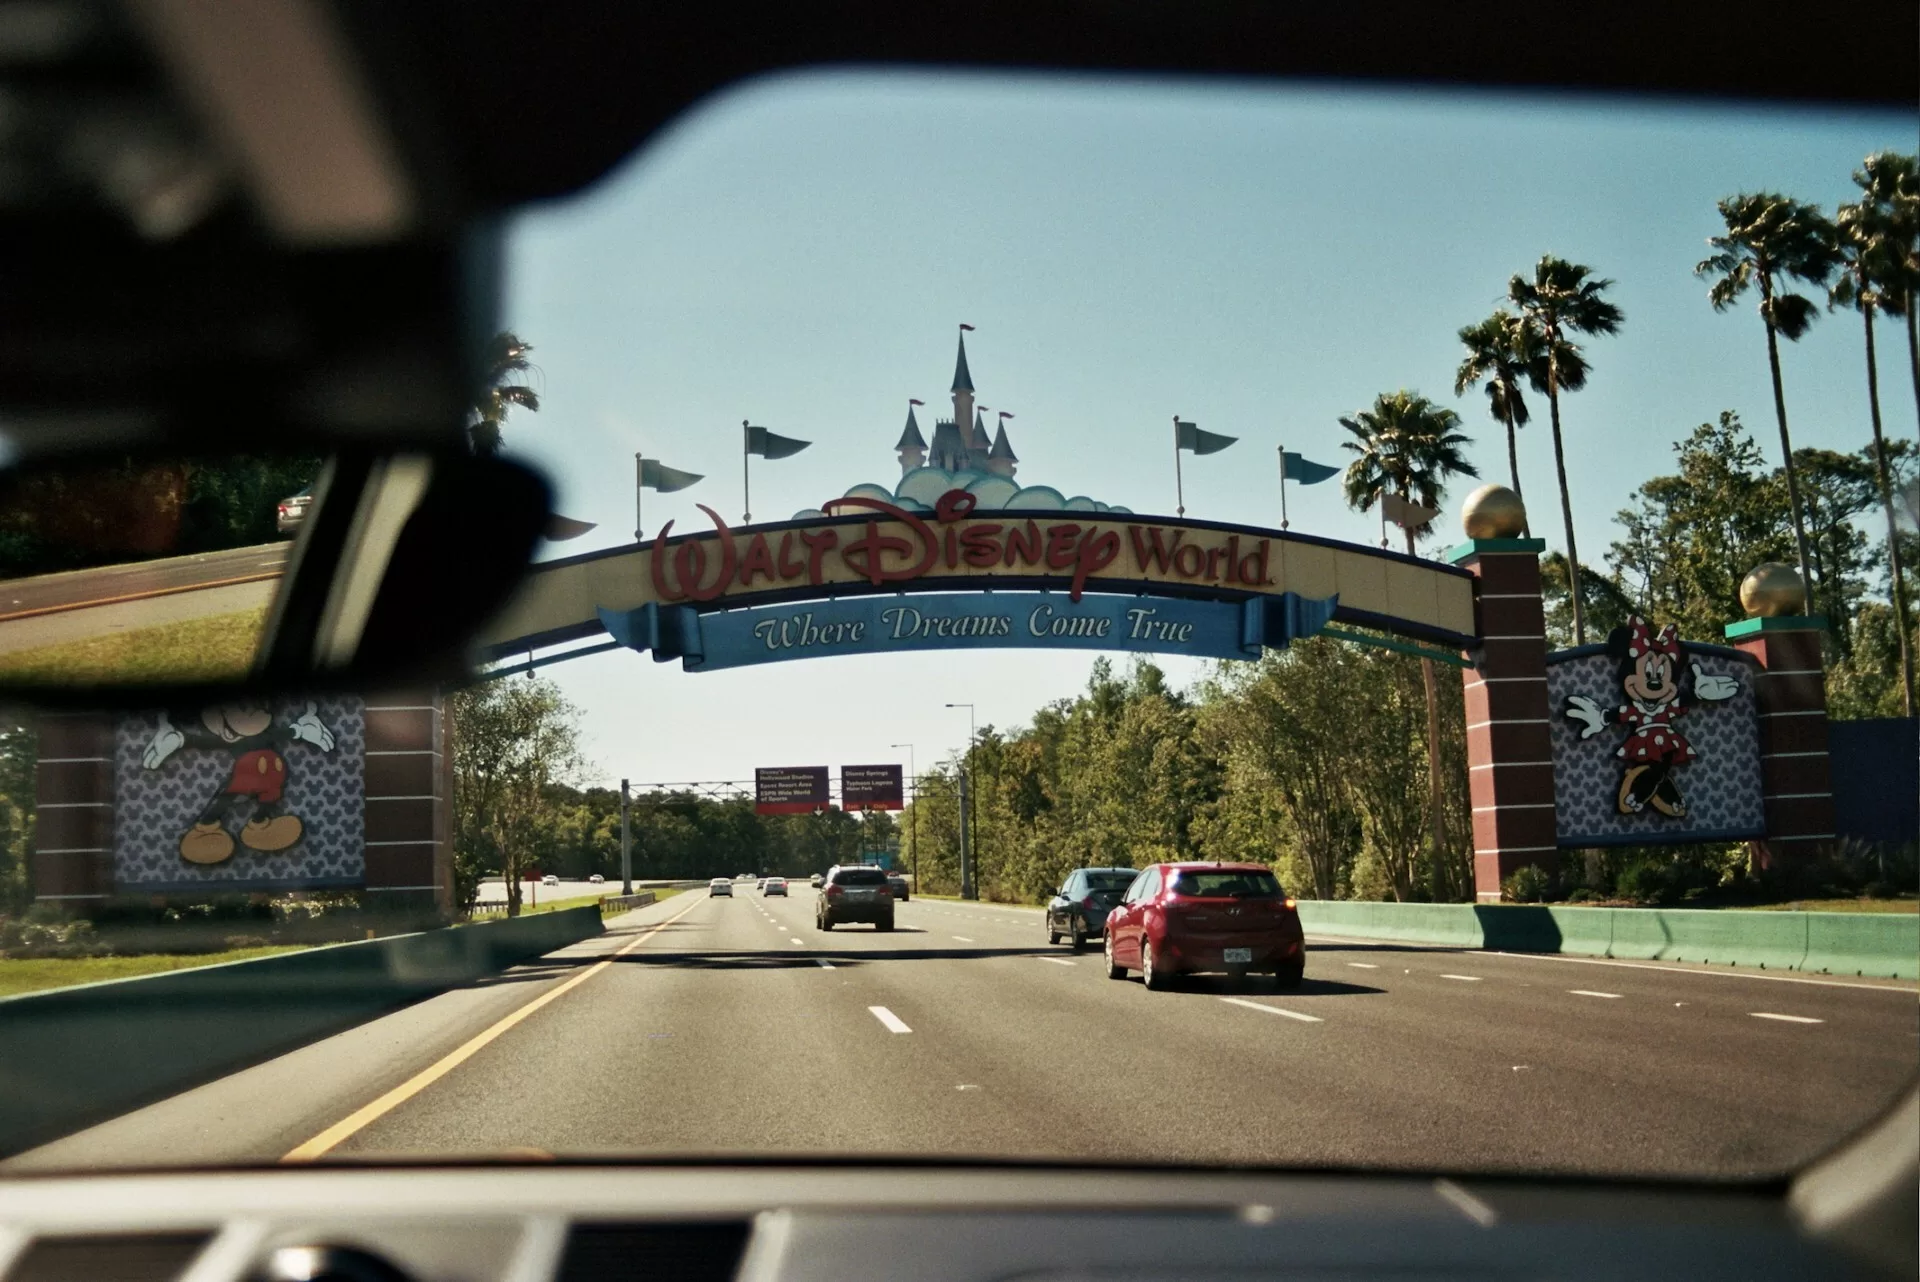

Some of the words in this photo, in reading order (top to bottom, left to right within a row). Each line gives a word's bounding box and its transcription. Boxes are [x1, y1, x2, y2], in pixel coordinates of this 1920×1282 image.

[754, 613, 865, 650] Where
[881, 607, 1011, 640] Dreams
[1029, 604, 1112, 637] Come
[1127, 608, 1193, 642] True
